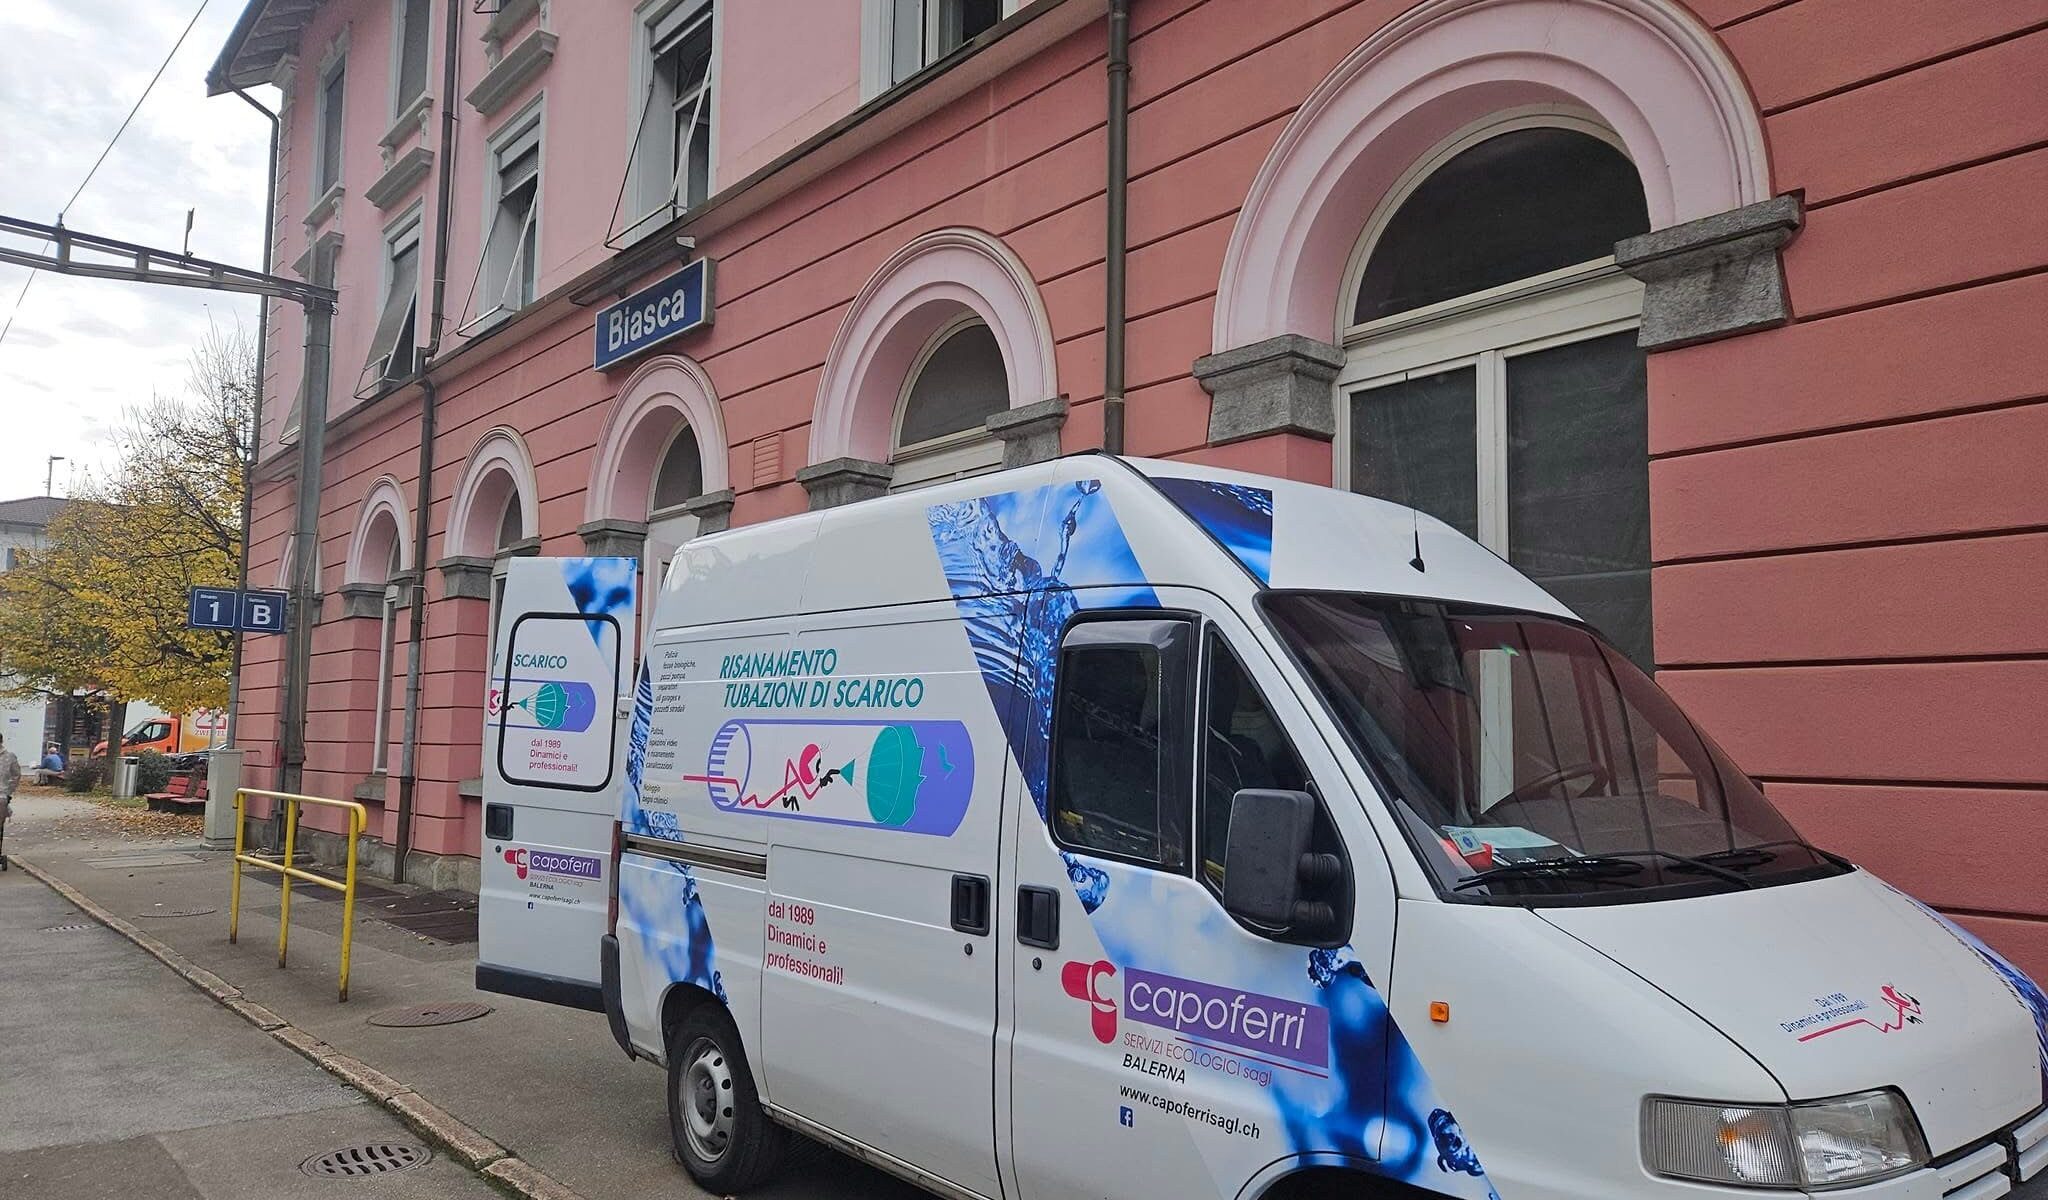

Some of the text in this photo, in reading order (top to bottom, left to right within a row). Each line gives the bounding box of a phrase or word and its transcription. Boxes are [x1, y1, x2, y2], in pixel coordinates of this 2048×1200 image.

[608, 288, 685, 352] Biasca
[209, 601, 219, 622] 1
[252, 604, 271, 625] B
[514, 654, 568, 669] SCARICO
[719, 648, 837, 678] RISANAMENTO
[723, 678, 924, 708] TUBAZIONI DI SCARICO
[530, 750, 561, 760] Dinamici
[531, 739, 561, 748] dal 1989
[529, 761, 578, 772] professionali!
[531, 855, 595, 875] capoferri
[529, 882, 554, 891] BALERNA
[768, 900, 815, 926] dal 1989
[767, 924, 827, 955] Dinamici e
[766, 953, 844, 986] professionali!
[1128, 981, 1307, 1050] capoferri
[1779, 1014, 1818, 1033] Dinamici
[1122, 1053, 1186, 1084] BALERNA
[1123, 1031, 1273, 1087] SERVIZI ECOLOGICI sagl
[1119, 1084, 1261, 1139] www.capoferrisagl.ch
